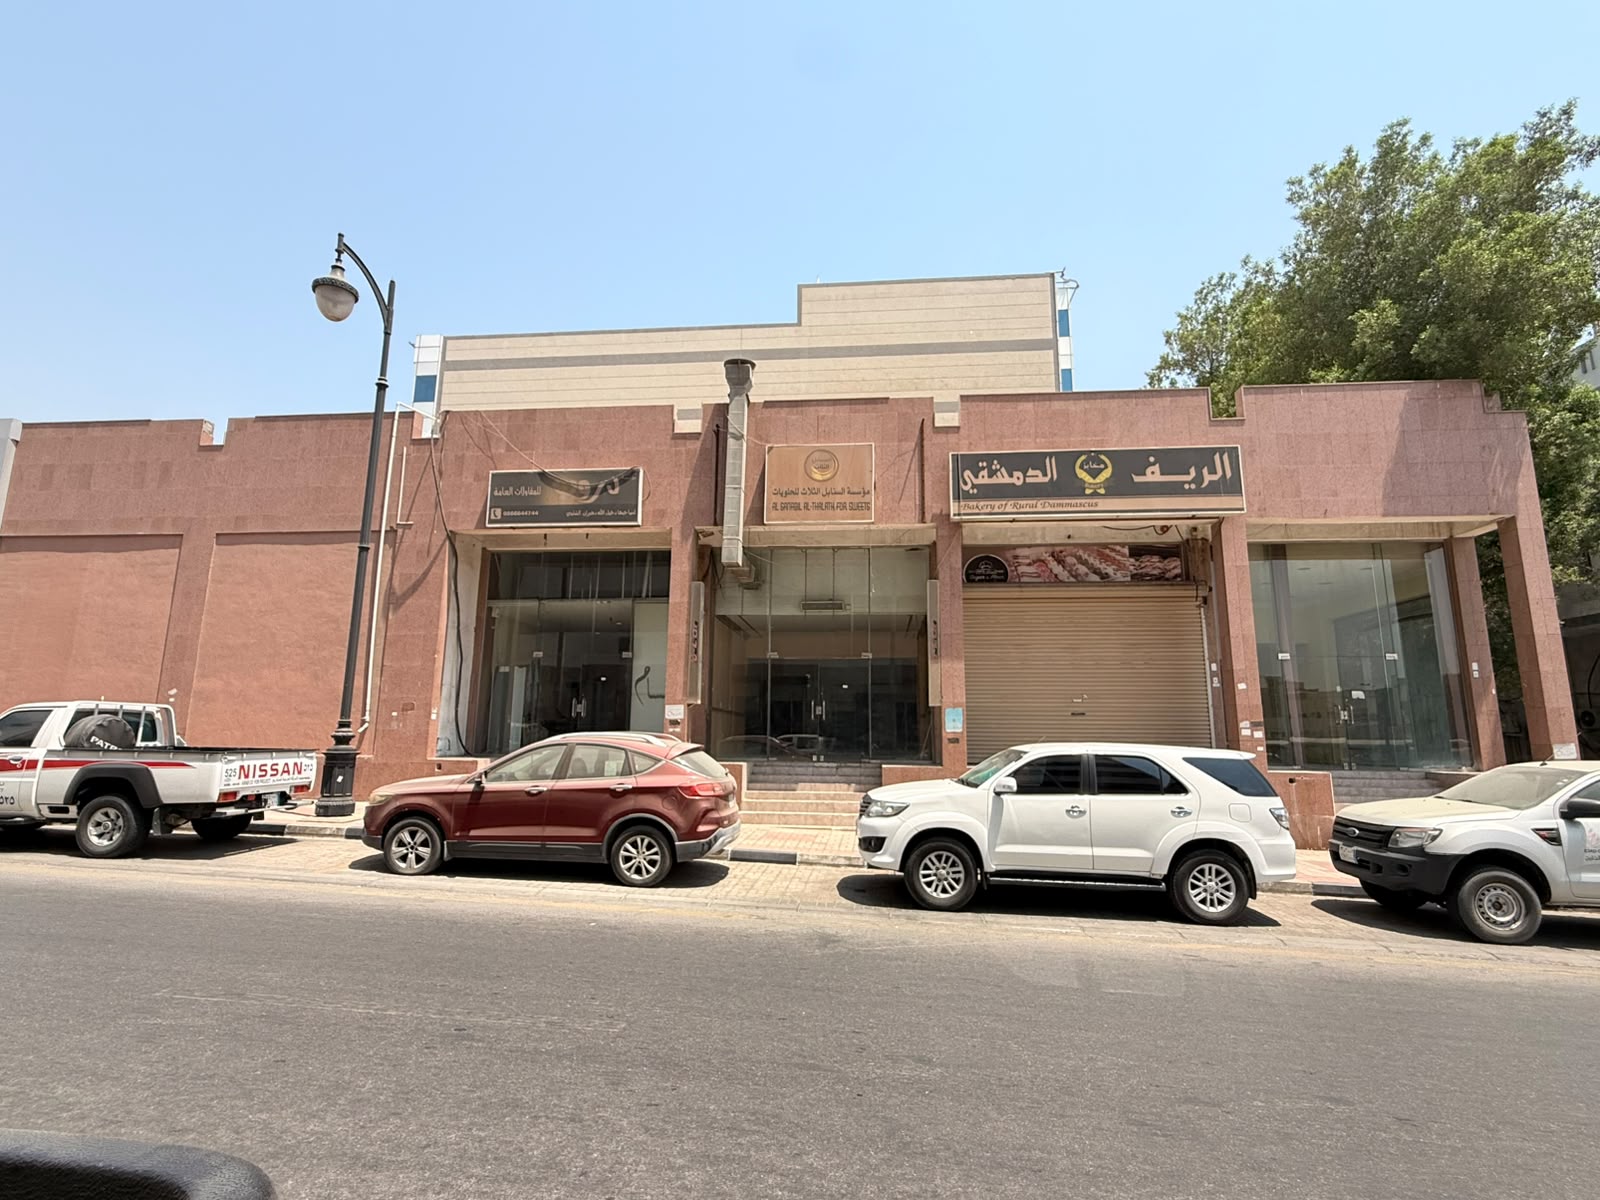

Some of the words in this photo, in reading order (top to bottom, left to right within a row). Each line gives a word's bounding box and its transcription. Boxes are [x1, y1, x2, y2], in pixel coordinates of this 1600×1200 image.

[960, 456, 1057, 494] الدمشقي
[1131, 451, 1232, 489] الريف
[772, 487, 799, 498] للحلويات
[801, 486, 820, 495] الثلاث
[822, 486, 845, 498] السنابل
[847, 486, 870, 498] مؤسسة
[836, 502, 847, 511] FOR
[849, 501, 870, 511] SWEETS
[961, 502, 995, 513] Bakery
[997, 501, 1010, 511] of
[1010, 501, 1038, 510] Rural
[1040, 500, 1098, 509] Dammascus
[90, 735, 122, 751] PATR
[224, 768, 237, 778] 525
[238, 761, 303, 780] NISSAN
